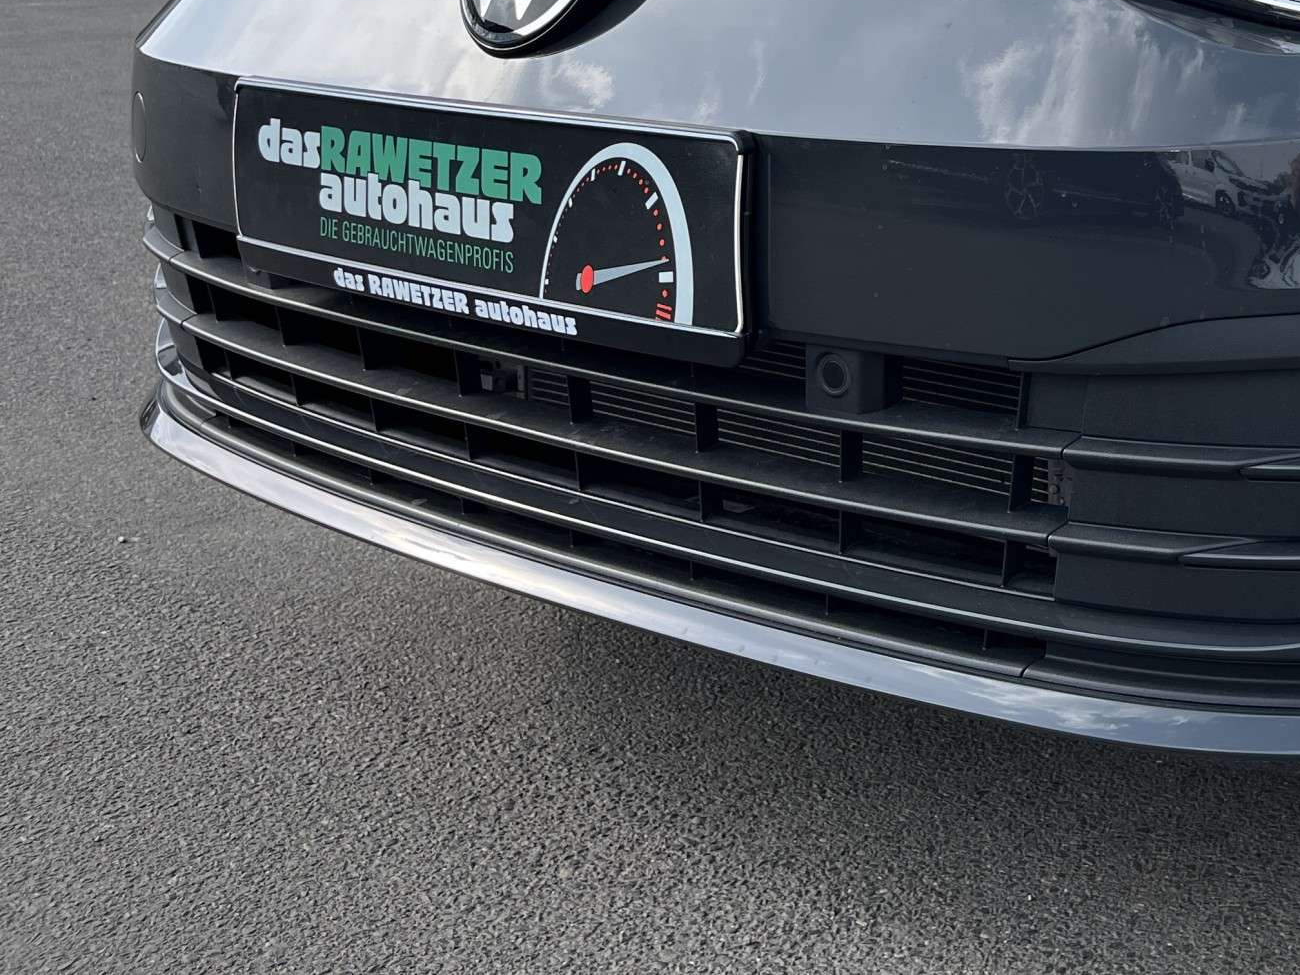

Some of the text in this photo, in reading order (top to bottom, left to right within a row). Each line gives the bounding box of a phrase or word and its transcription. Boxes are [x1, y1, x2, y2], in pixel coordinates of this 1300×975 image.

[319, 172, 514, 244] autohaus
[319, 216, 514, 274] DIE GEBRAUCHTWAGENPROFIS
[333, 267, 578, 337] das RAWETZER autohaus
